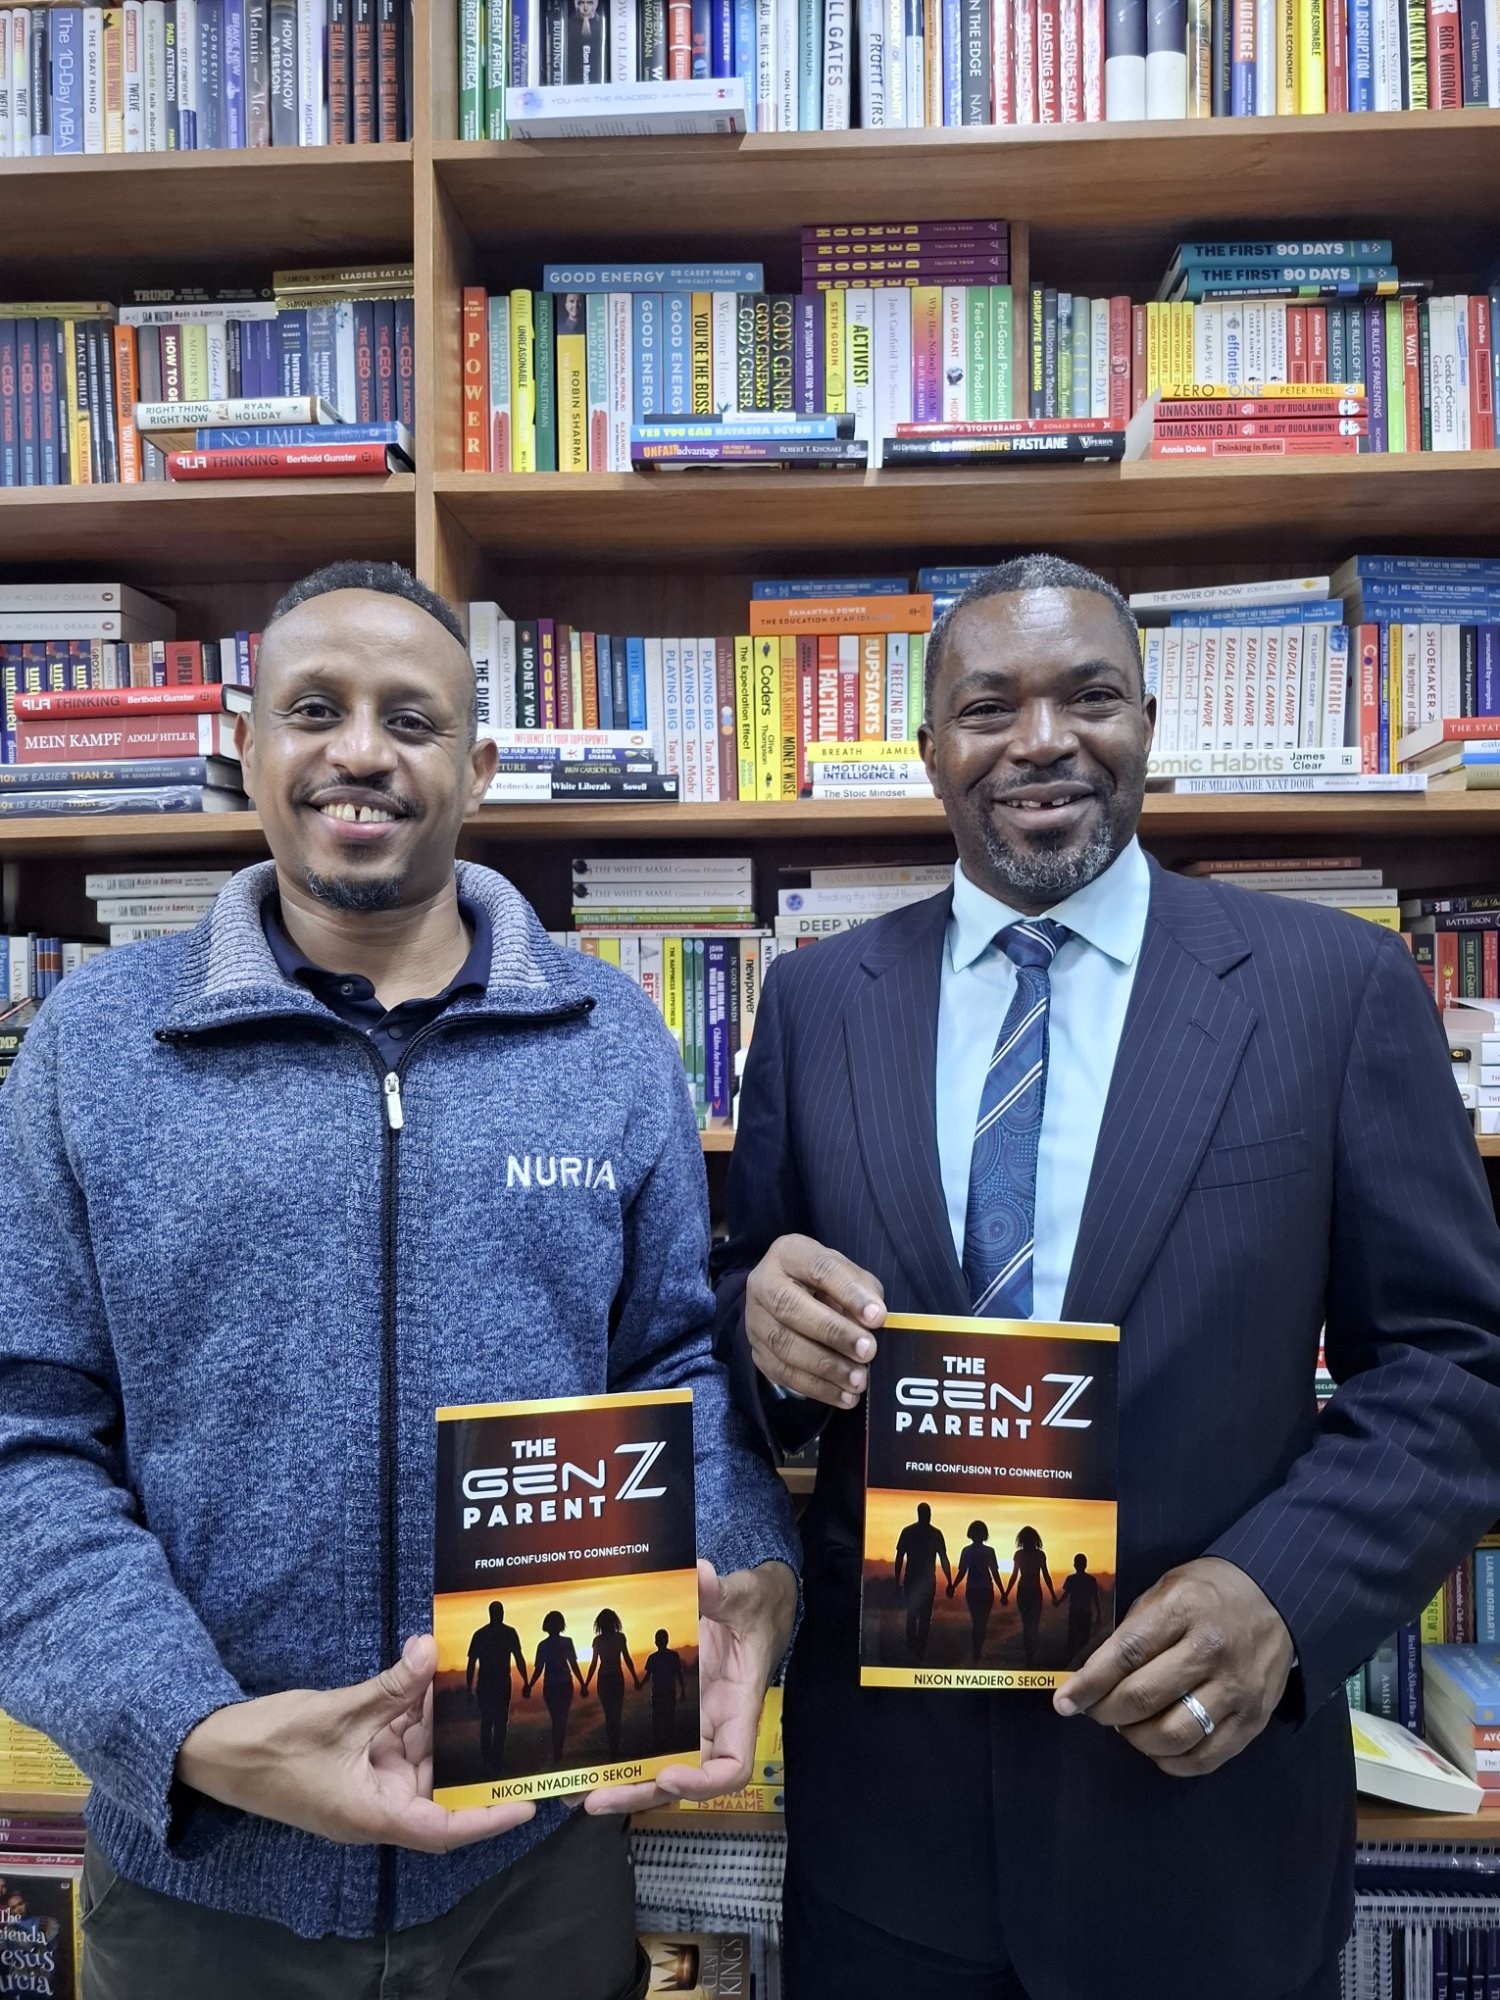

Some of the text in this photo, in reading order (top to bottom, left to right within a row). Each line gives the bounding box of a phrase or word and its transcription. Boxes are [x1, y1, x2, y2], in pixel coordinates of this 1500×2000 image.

[828, 29, 843, 86] GATES
[969, 14, 981, 77] THE EDGE
[1042, 12, 1054, 76] CHASING
[1356, 22, 1370, 79] DISRUPTION
[166, 23, 176, 101] PAID ATTENTION
[271, 36, 281, 95] A PERSON
[282, 20, 293, 111] HOW TO KNOW
[466, 46, 476, 90] AFRICA
[870, 33, 883, 87] PROFIT
[1286, 32, 1294, 89] ECONOMICS
[55, 14, 75, 148] The 10-Day MBA
[129, 83, 139, 112] TWELVE
[816, 225, 919, 238] HOOKED
[1194, 243, 1344, 257] THE FIRST 90 DAYS
[549, 272, 596, 283] GOOD
[601, 271, 665, 283] ENERGY
[1201, 268, 1351, 282] THE FIRST 90 DAYS
[517, 325, 527, 388] UNREASONABLE
[694, 312, 709, 415] YOU'RE THE BOSS
[852, 325, 869, 385] ACTIVIST
[1371, 310, 1382, 418] THE RULES OF PARENTING
[463, 332, 484, 453] POWER
[1173, 384, 1215, 397] ZERO
[1228, 384, 1263, 397] ONE
[1280, 386, 1306, 395] PETER
[1311, 386, 1335, 395] THIEL
[145, 405, 211, 415] RIGHT THING,
[150, 414, 208, 424] RIGHT NOW
[235, 411, 281, 420] HOLIDAY
[244, 402, 272, 411] RYAN
[572, 370, 581, 465] ROBIN SHARMA
[1159, 403, 1335, 417] UNMASKING AI DR. JOY BUOLAMWINI
[220, 429, 315, 447] NO LIMITS
[1012, 437, 1068, 451] FASTLANE
[1160, 445, 1207, 454] Annie Duke
[1217, 443, 1252, 454] Thinking
[1262, 443, 1280, 451] Bets
[212, 453, 356, 468] THINKING Berthold Gunster
[1153, 586, 1242, 603] THE POWER OF NOW
[1202, 638, 1216, 728] RADICAL CANDOR
[1427, 631, 1436, 708] SHOEMAKER
[476, 659, 490, 725] THE DIARY
[684, 650, 695, 731] PLAYING BIG
[740, 646, 750, 750] The Expectation Effect
[761, 665, 774, 716] Coders
[865, 645, 880, 735] UPSTARTS
[24, 731, 196, 750] MEIN KAMPF ADOLF HITLER
[822, 747, 916, 756] BREATH JAMES
[783, 736, 796, 795] MONEY WISE
[824, 764, 896, 772] EMOTIONAL
[1210, 752, 1284, 774] Habits
[1290, 752, 1325, 761] James
[1293, 761, 1322, 770] Clear
[19, 773, 29, 782] IS
[31, 771, 68, 781] EASIER
[70, 770, 100, 780] THAN
[102, 770, 115, 780] 2x
[552, 782, 647, 791] White Liberals Sowell
[823, 771, 896, 780] INTELLIGENCE
[1190, 778, 1314, 792] THE MILLIONAIRE NEXT DOOR
[824, 788, 906, 798] The Stoic Mindset
[594, 866, 672, 874] THE WHITE MASAI
[799, 919, 842, 932] DEEP
[1445, 917, 1491, 926] BATTERSON
[745, 959, 755, 1015] newpower
[506, 1155, 616, 1191] NURIA
[942, 1355, 986, 1375] THE
[895, 1373, 1094, 1429] GEN Z
[895, 1411, 1032, 1440] PARENT
[511, 1437, 556, 1460] THE
[461, 1440, 667, 1501] GEN Z
[905, 1461, 1073, 1480] FROM CONFUSION TO CONNECTION
[462, 1495, 606, 1530] PARENT
[474, 1542, 650, 1569] FROM CONFUSION TO CONNECTION
[1486, 1556, 1495, 1641] LIANE MORIARTY
[913, 1672, 1056, 1687] NIXON NYADIERO SEKOH
[1381, 1673, 1390, 1715] AMISH
[491, 1764, 642, 1800] NIXON NYADIERO SEKOH
[714, 1799, 765, 1811] MAAME
[720, 1938, 743, 1996] KINGS
